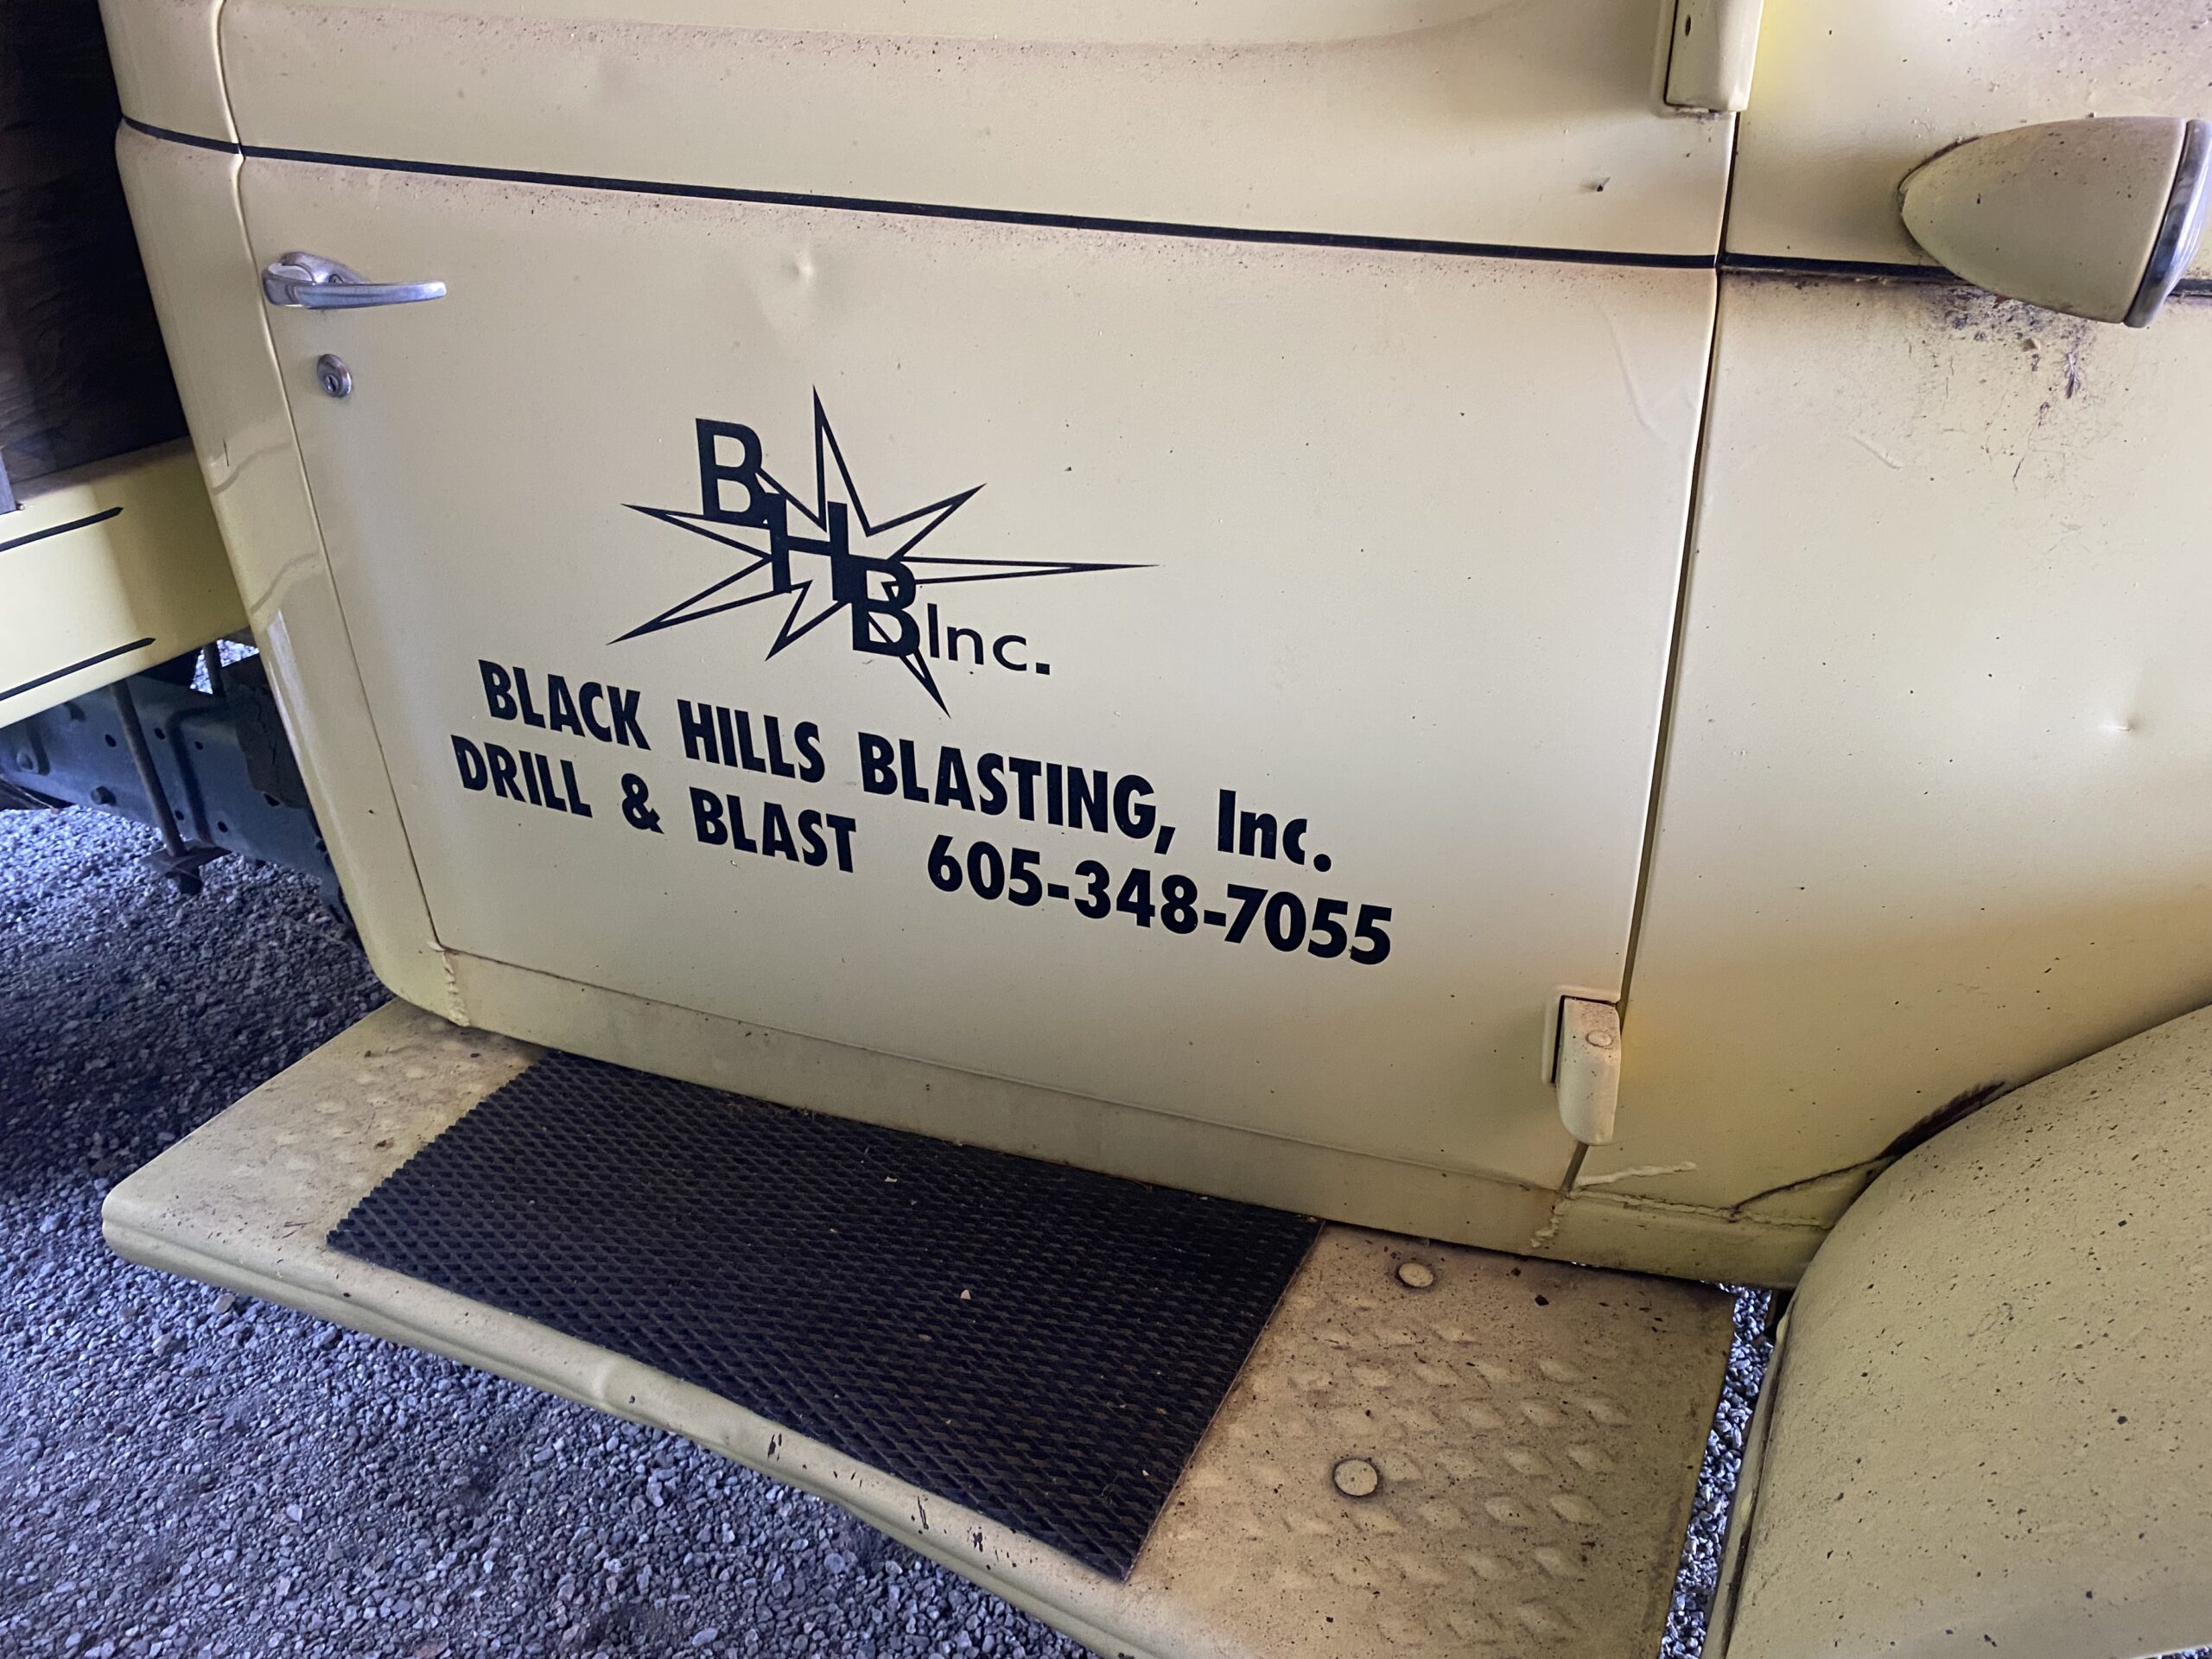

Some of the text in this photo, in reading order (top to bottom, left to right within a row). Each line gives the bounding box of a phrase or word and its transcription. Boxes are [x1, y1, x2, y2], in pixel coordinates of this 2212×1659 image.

[695, 417, 1052, 677] BHB Inc.
[450, 734, 1393, 966] DRILL & BLAST 605-348-7055
[478, 658, 1332, 873] BLACK HILLS BLASTING, Inc.
